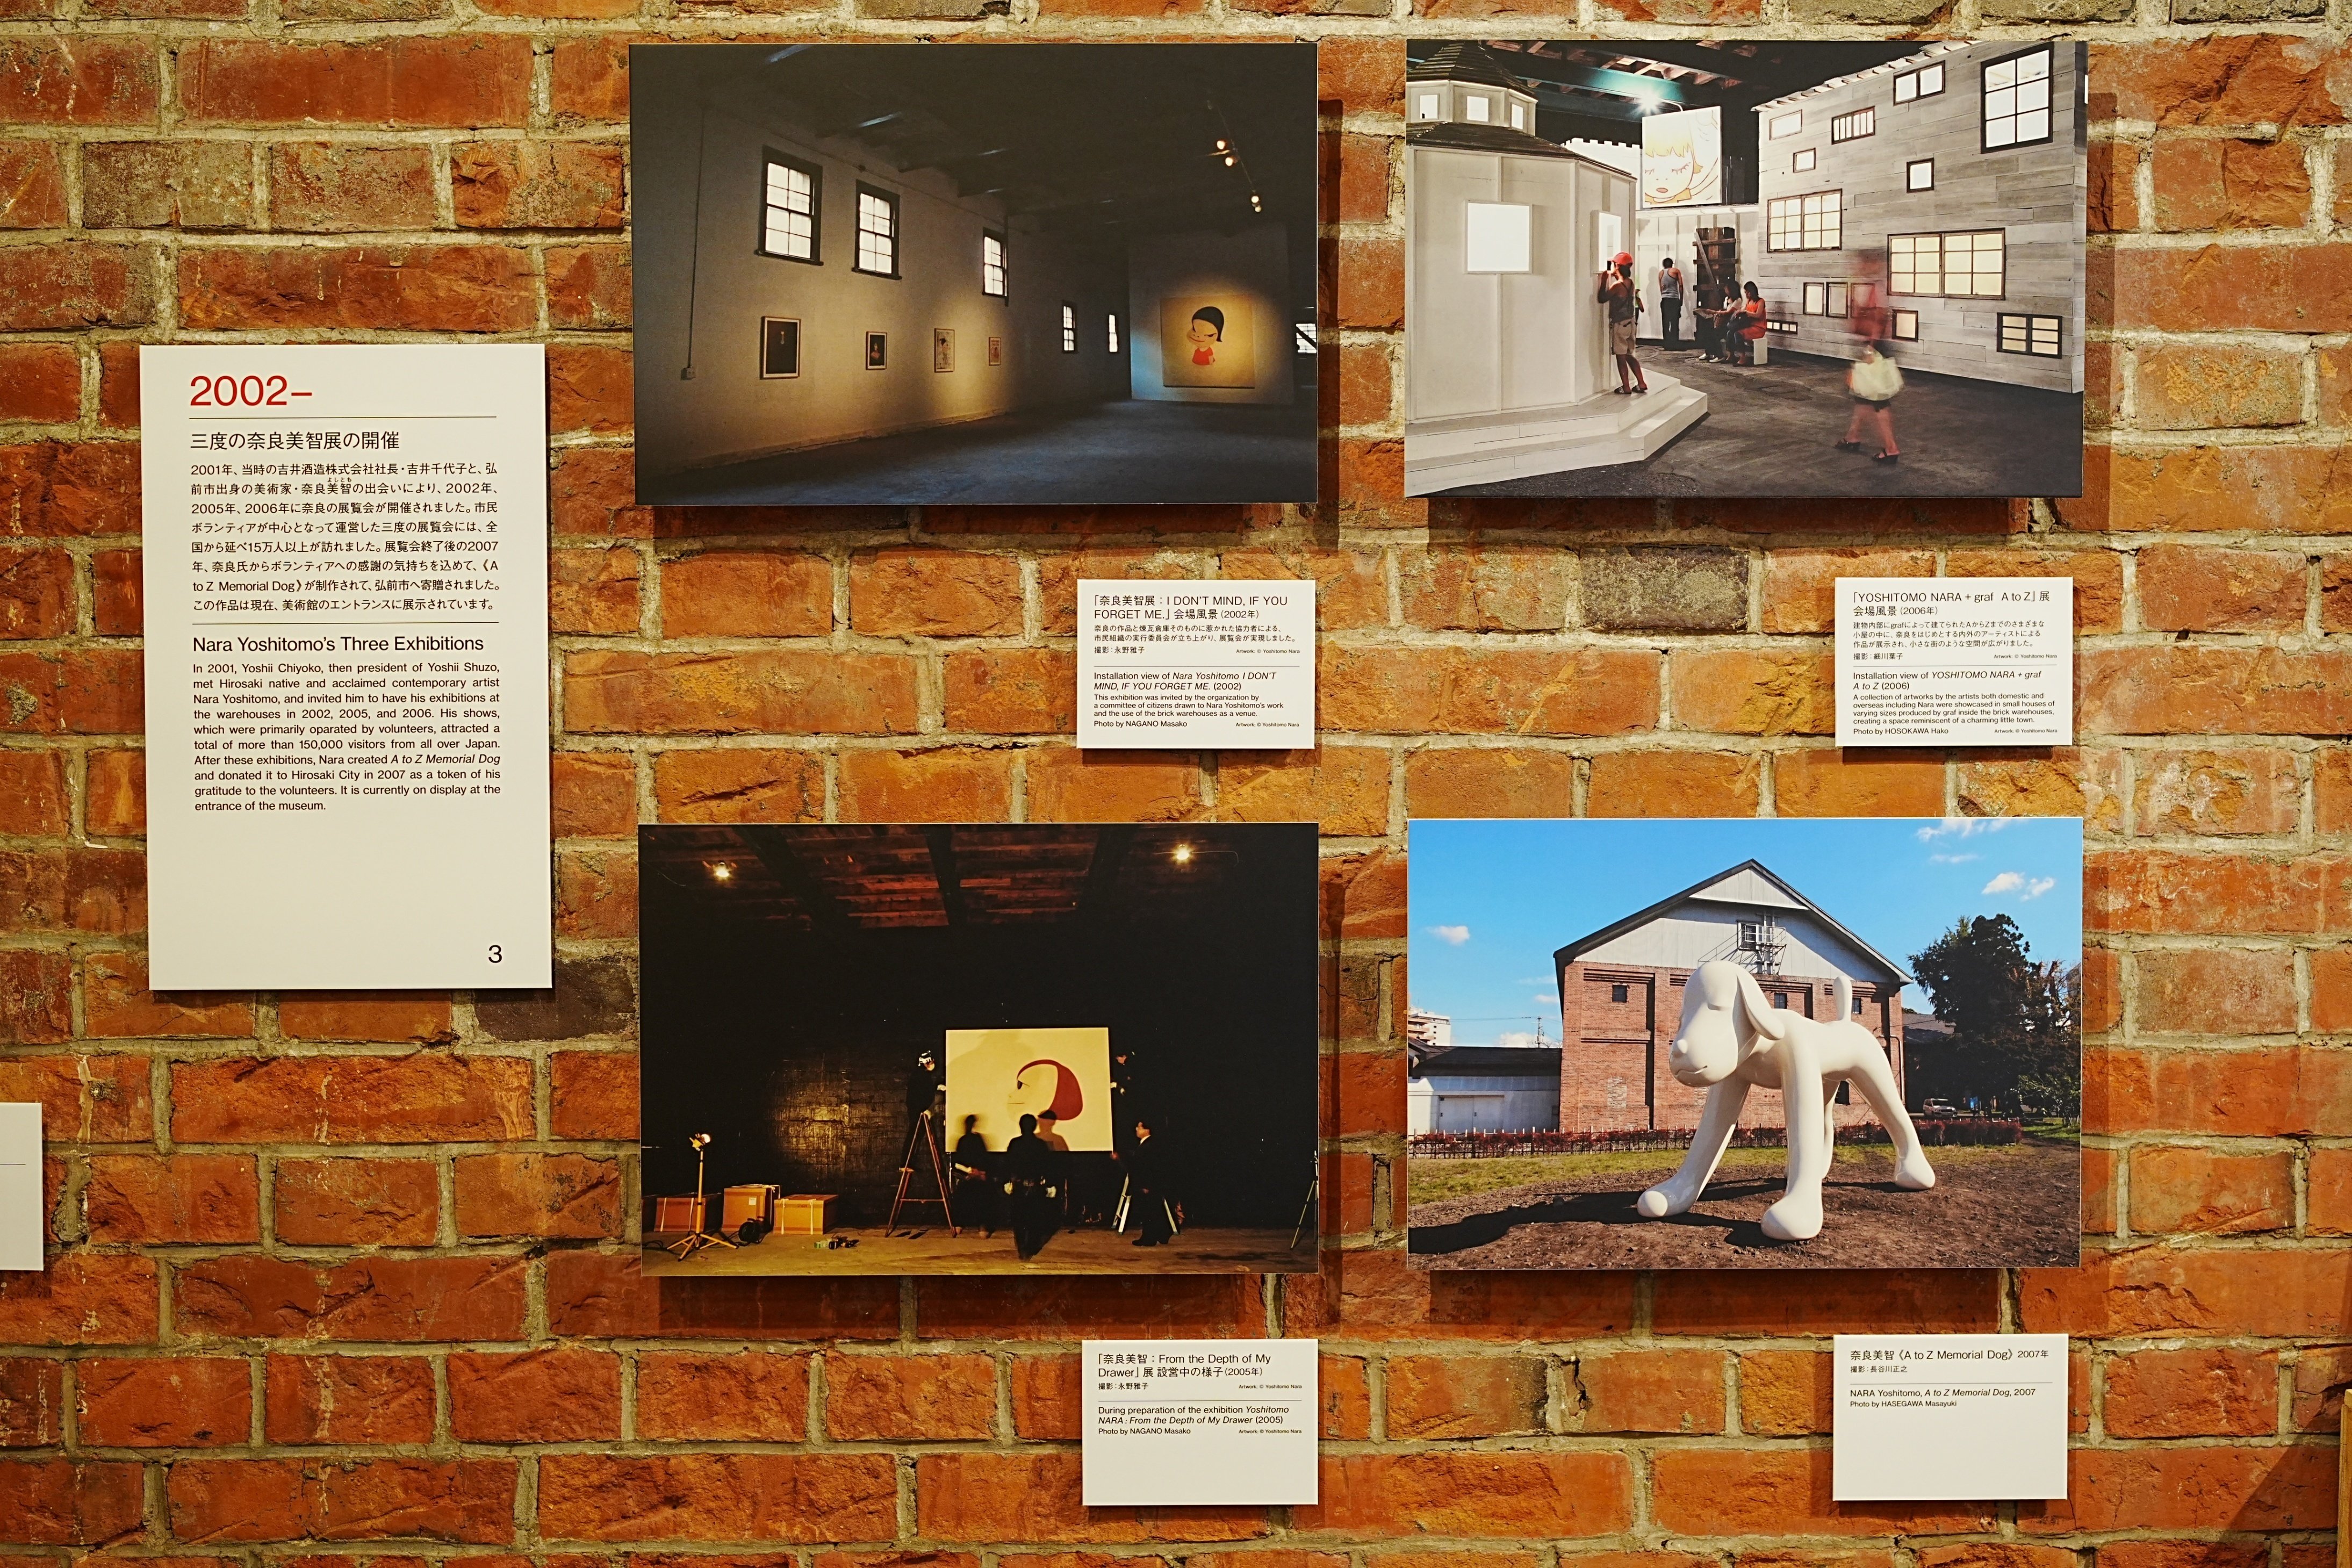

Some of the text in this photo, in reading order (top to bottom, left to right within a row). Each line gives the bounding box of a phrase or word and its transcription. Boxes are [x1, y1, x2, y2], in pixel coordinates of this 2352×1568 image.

[190, 431, 400, 450] 三度の奈良美智展の開催
[1213, 596, 1246, 607] MIND,
[1249, 596, 1260, 606] IF
[1263, 596, 1288, 606] YOU
[1931, 592, 1962, 602] NARA
[1974, 592, 1994, 603] graf
[2001, 592, 2009, 601] A
[2011, 593, 2022, 601] to
[1094, 609, 1141, 620] FORGET
[1173, 608, 1219, 620] 会場風景
[1853, 606, 1898, 617] 会場風景
[193, 637, 233, 652] Nara
[340, 636, 389, 651] Three
[394, 636, 484, 651] Exhibitions
[193, 662, 500, 675] In 2001, Yoshii Chiyoko, then president of Yoshii Shuzo,
[1094, 672, 1139, 680] Installation
[1140, 672, 1160, 680] view
[1161, 672, 1170, 680] of
[1172, 672, 1193, 680] Nara
[1196, 672, 1240, 680] Yoshitomo
[1242, 672, 1246, 680] I
[1853, 672, 1897, 680] Installation
[1920, 671, 1929, 679] of
[1932, 671, 1988, 679] YOSHITOMO
[1989, 671, 2015, 679] NARA
[2024, 670, 2042, 680] graf
[1862, 682, 1871, 691] to
[1872, 682, 1880, 690] Z
[1881, 681, 1910, 691] (2006)
[1935, 693, 1944, 701] by
[193, 708, 500, 720] the warehouses in 2002, 2005, and 2006. His shows,
[193, 724, 225, 735] which
[229, 727, 256, 735] were
[260, 724, 305, 736] primarily
[309, 724, 357, 736] oparated
[362, 724, 375, 736] by
[378, 724, 436, 735] volunteers,
[441, 723, 489, 733] attracted
[1116, 720, 1124, 729] by
[195, 801, 242, 811] entrance
[244, 801, 256, 811] of
[258, 801, 276, 810] the
[488, 944, 502, 963] 3
[1159, 1354, 1185, 1364] From
[1188, 1354, 1205, 1364] the
[1208, 1354, 1239, 1365] Depth
[1241, 1354, 1253, 1363] of
[1256, 1354, 1271, 1365] My
[1914, 1351, 1924, 1360] to
[1926, 1350, 1934, 1360] Z
[1937, 1350, 1983, 1360] Memorial
[2017, 1349, 2049, 1358] 2007年
[1850, 1389, 1875, 1397] NARA
[1878, 1389, 1923, 1398] Yoshitomo,
[1924, 1389, 1931, 1397] A
[1943, 1389, 1950, 1397] Z
[1952, 1389, 1991, 1397] Memorial
[1992, 1388, 2012, 1398] Dog,
[2013, 1388, 2036, 1396] 2007
[1925, 1400, 1957, 1408] Masayuki
[1098, 1406, 1290, 1416] During preparation of the exhibition Yoshitomo
[1129, 1416, 1151, 1425] From
[1153, 1416, 1167, 1425] the
[1169, 1416, 1195, 1426] Depth
[1196, 1416, 1206, 1424] of
[1207, 1416, 1221, 1426] My
[1222, 1415, 1254, 1424] Drawer
[1255, 1415, 1283, 1425] (2005)
[1119, 1428, 1128, 1436] by
[1130, 1427, 1163, 1435] NAGANO
